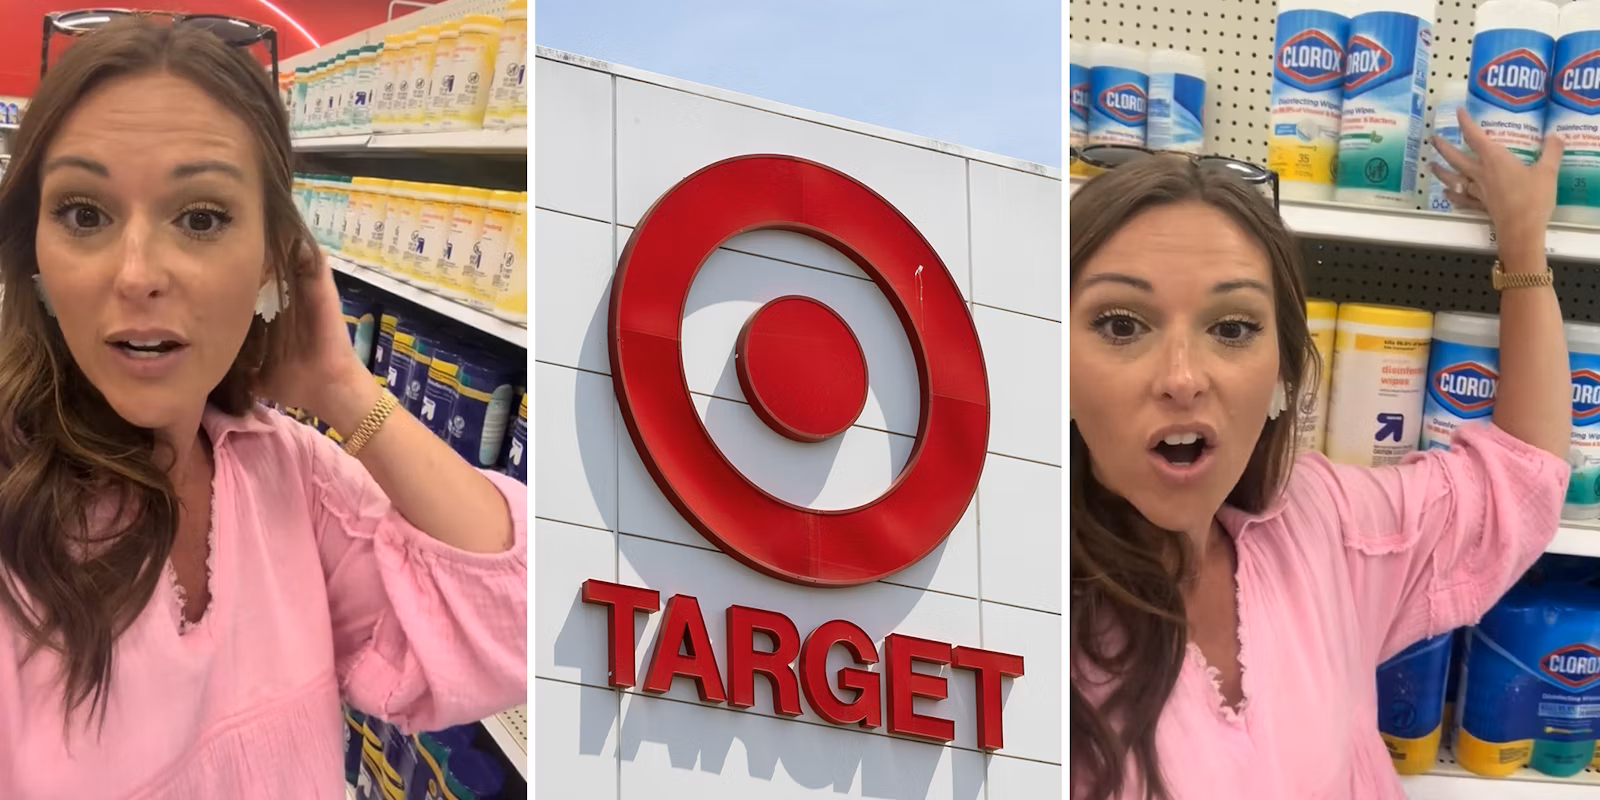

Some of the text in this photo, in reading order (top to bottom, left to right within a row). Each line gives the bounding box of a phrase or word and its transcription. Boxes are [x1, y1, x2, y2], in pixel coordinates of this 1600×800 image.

[1282, 46, 1342, 73] CLOROX
[1346, 49, 1381, 73] OROX
[1486, 65, 1546, 92] CLOROX
[1106, 91, 1147, 113] CLORO
[1380, 377, 1410, 387] wipes
[581, 578, 1025, 752] TARGET
